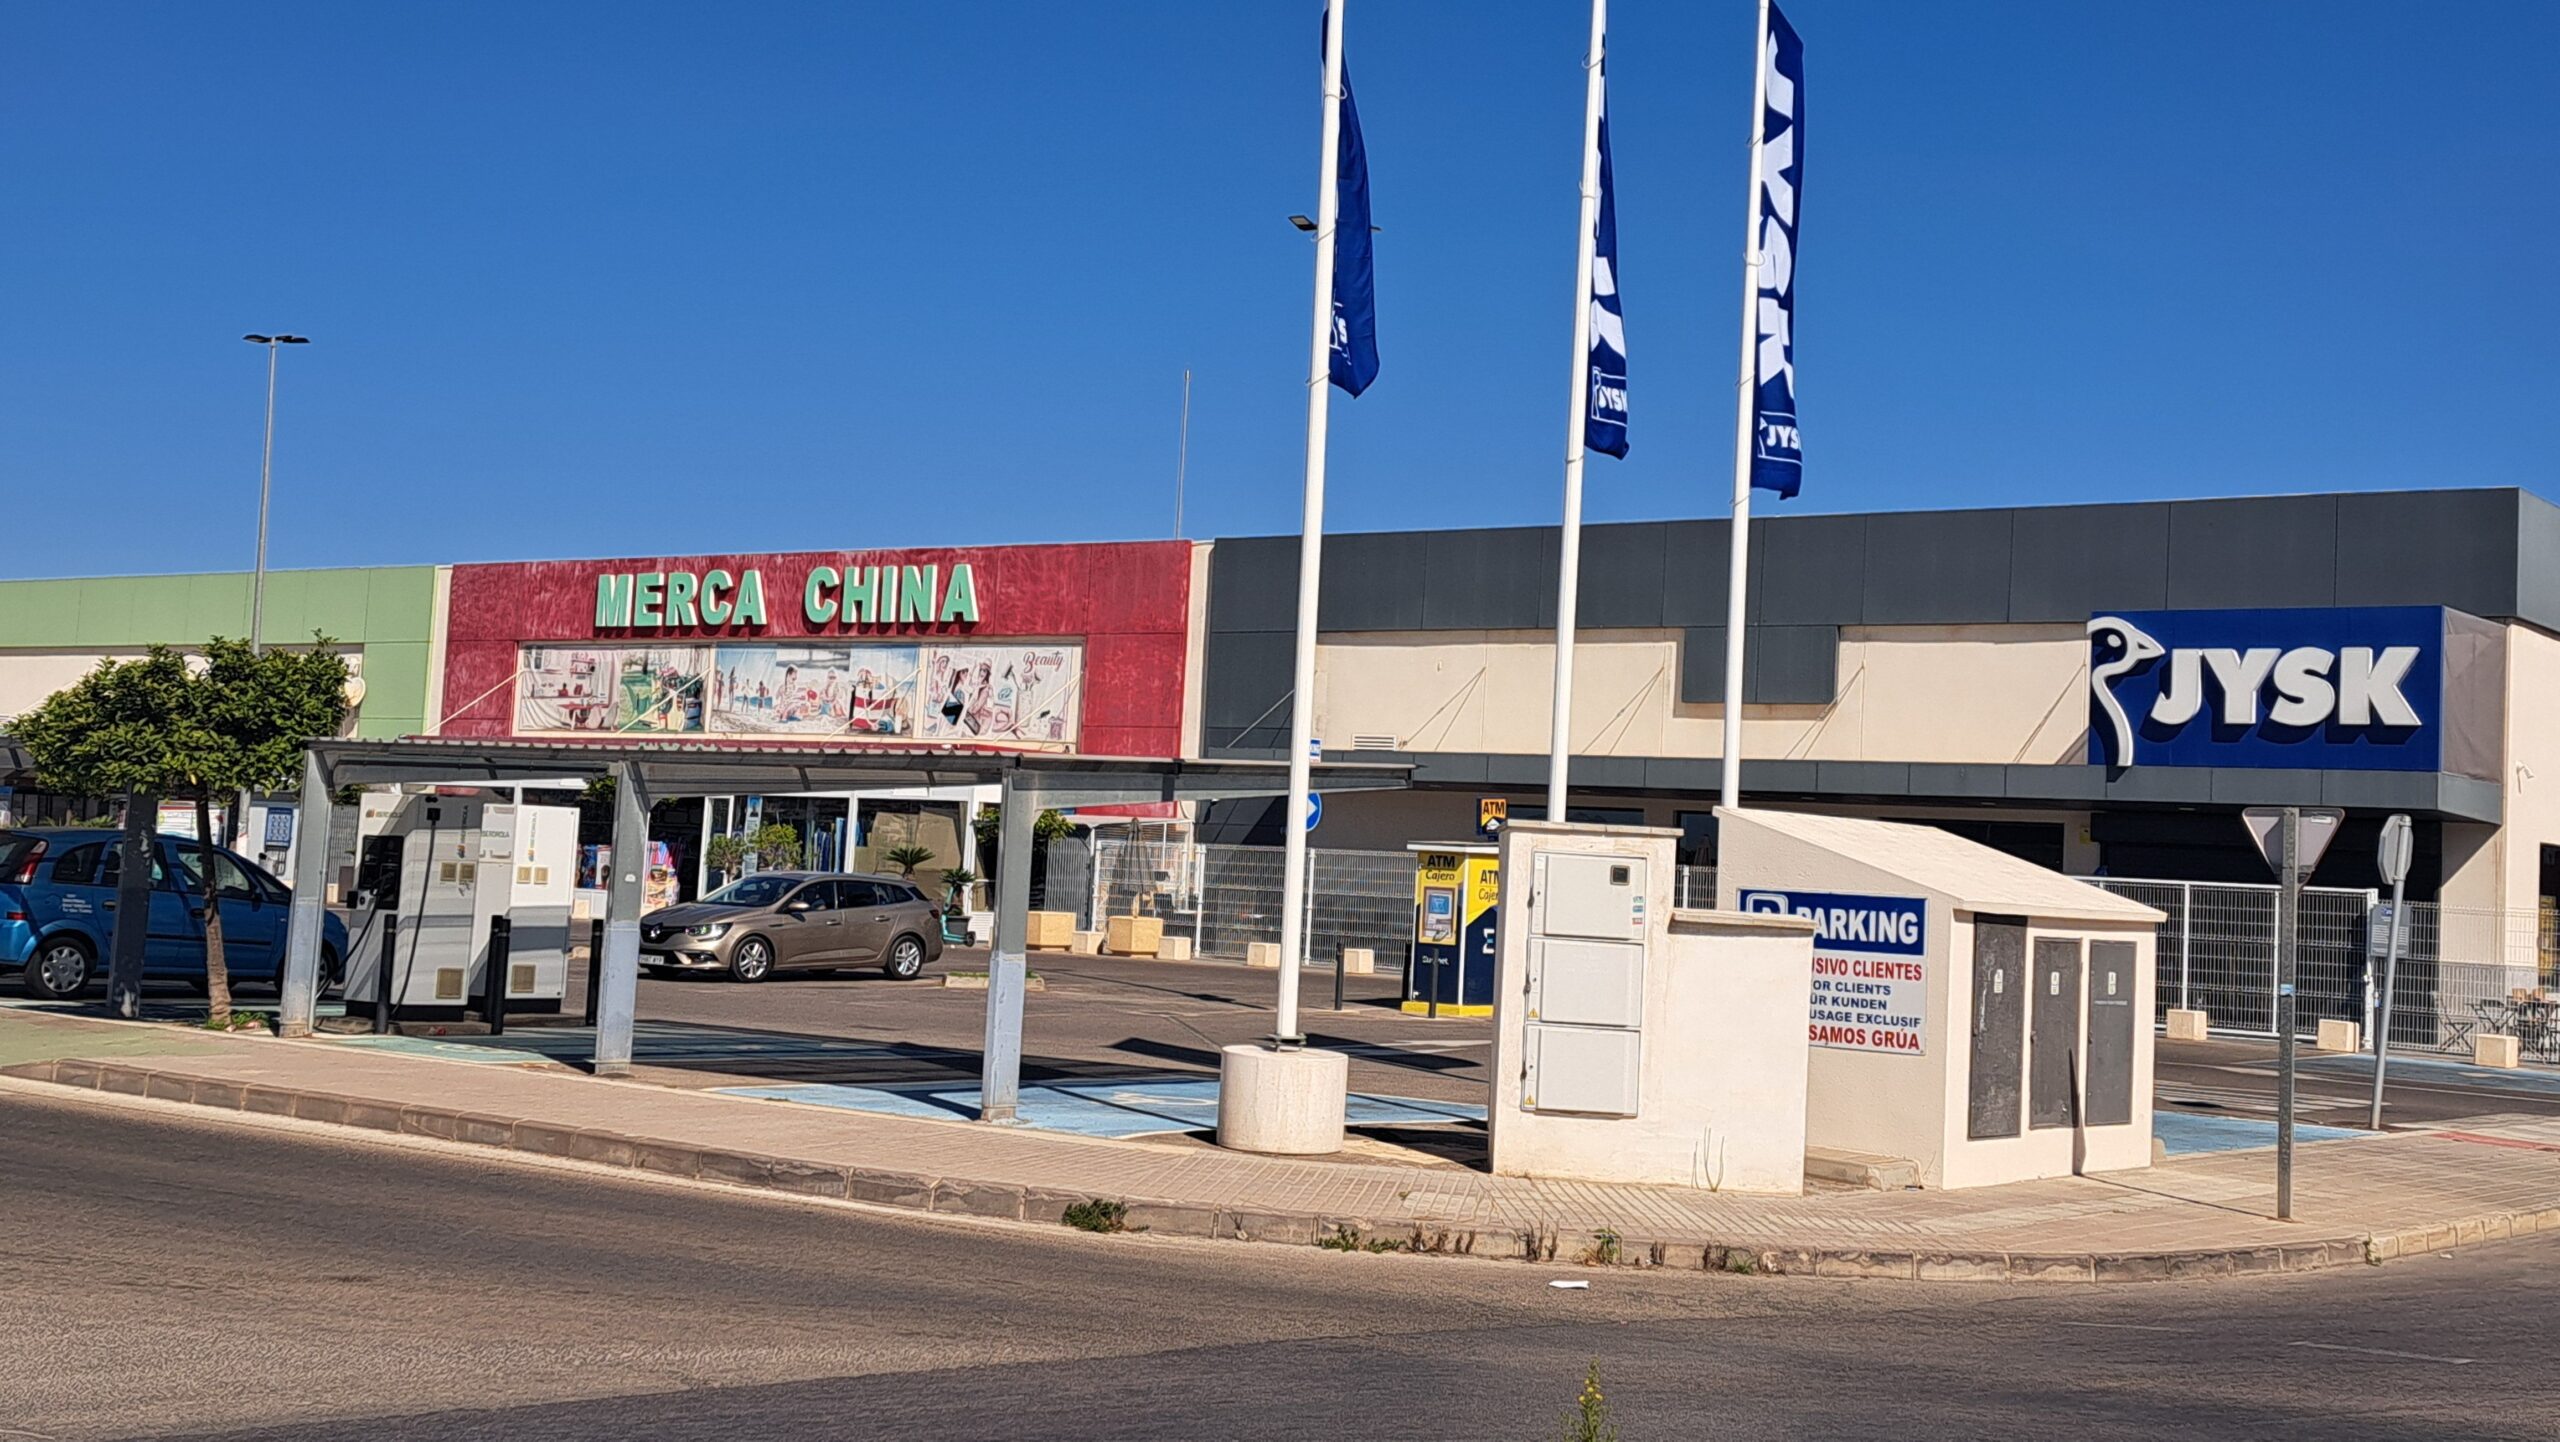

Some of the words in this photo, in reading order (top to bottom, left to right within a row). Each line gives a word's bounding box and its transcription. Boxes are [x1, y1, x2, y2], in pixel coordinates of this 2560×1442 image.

[1766, 424, 1801, 451] JYS
[595, 569, 768, 628] MERCA
[804, 564, 980, 625] CHINA
[1023, 651, 1064, 673] Beauty
[2149, 646, 2423, 727] JYSK
[1482, 801, 1505, 816] ATM
[1427, 854, 1456, 868] ATM
[1425, 869, 1456, 882] Cajero
[1853, 959, 1922, 982] CLIENTES
[1835, 981, 1891, 996] CLIENTS
[1832, 995, 1887, 1011] KUNDEN
[1857, 1012, 1922, 1029] EXCLUSIF
[1871, 1027, 1920, 1051] GRÚA
